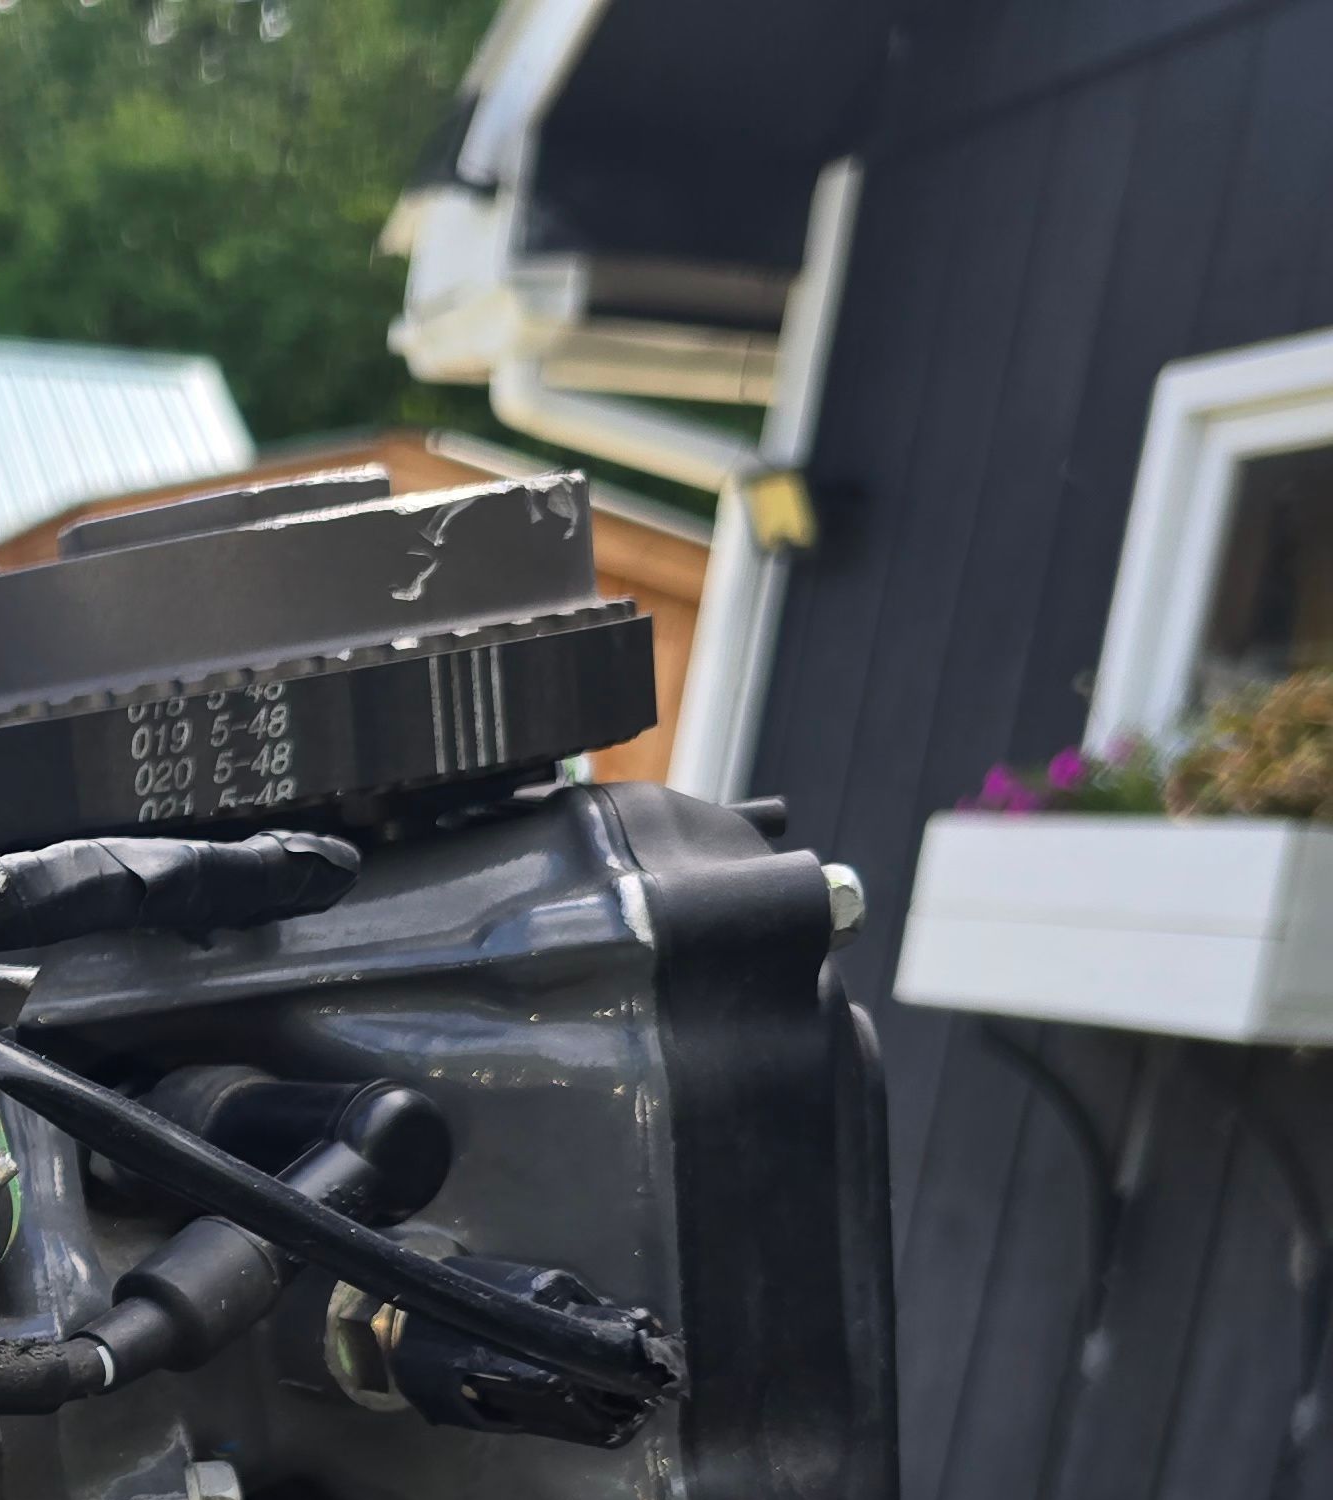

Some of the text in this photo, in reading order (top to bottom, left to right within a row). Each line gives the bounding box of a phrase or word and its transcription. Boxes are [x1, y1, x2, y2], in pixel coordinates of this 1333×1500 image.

[131, 704, 289, 760] 019 5-48
[134, 741, 293, 796] 020 5-48
